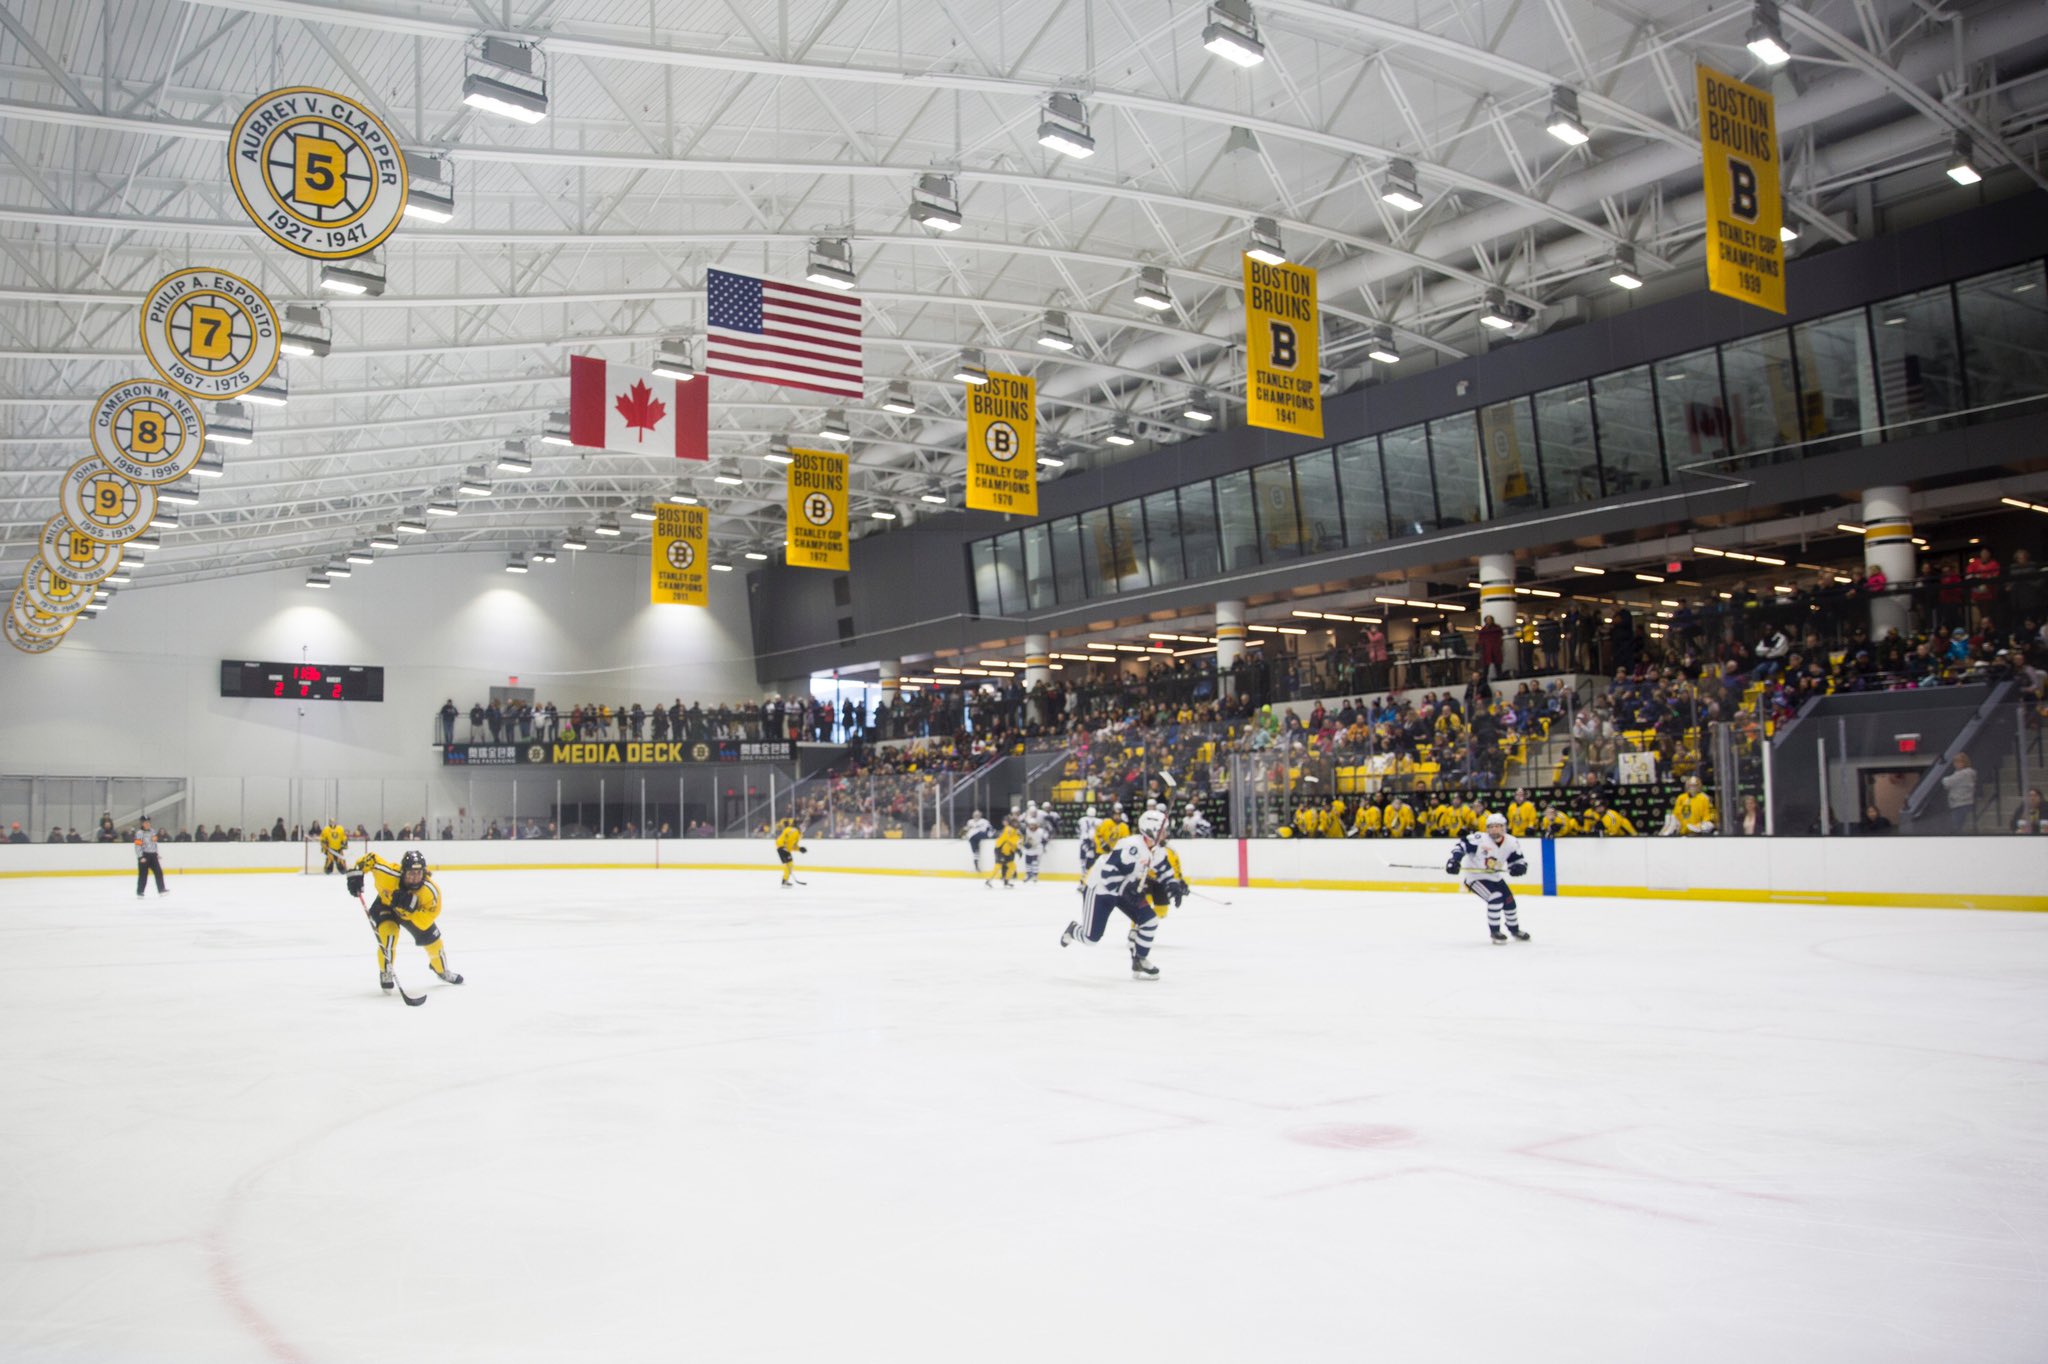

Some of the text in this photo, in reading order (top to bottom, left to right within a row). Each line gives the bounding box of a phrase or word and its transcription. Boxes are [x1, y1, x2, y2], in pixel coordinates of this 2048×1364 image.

[1706, 77, 1768, 129] BOSTON
[241, 97, 397, 186] AUBREY V. CLAPPER
[1708, 110, 1771, 162] BRUINS
[304, 152, 335, 191] 5
[1728, 157, 1759, 221] B
[1718, 220, 1777, 255] STANLEY CUP
[1719, 242, 1779, 277] CHAMPIONS
[1251, 261, 1310, 297] BOSTON
[150, 276, 272, 338] PHILIP A. ESPOSITO
[1252, 286, 1311, 322] BRUINS
[200, 317, 221, 347] 7
[1270, 320, 1297, 367] B
[1256, 369, 1313, 393] STANLEY CUP
[974, 394, 1029, 421] BRUINS
[1256, 386, 1315, 411] CHAMPIONS
[98, 385, 198, 438] CAMERON M. NEELY
[1276, 408, 1296, 424] 1941
[138, 420, 157, 444] 8
[995, 429, 1010, 452] B
[72, 461, 99, 483] JOHN
[793, 453, 843, 474] BOSTON
[975, 462, 1029, 480] STANLEY CUP
[793, 470, 843, 491] BRUINS
[975, 476, 1030, 495] CHAMPIONS
[101, 489, 116, 509] 9
[812, 499, 826, 518] B
[993, 492, 1013, 506] 1970
[658, 507, 703, 525] BOSTON
[658, 522, 703, 540] BRUINS
[794, 526, 827, 539] STANLEY
[74, 537, 90, 555] 15
[794, 538, 843, 552] CHAMPIONS
[54, 574, 68, 590] 16
[553, 742, 683, 764] MEDIA DECK
